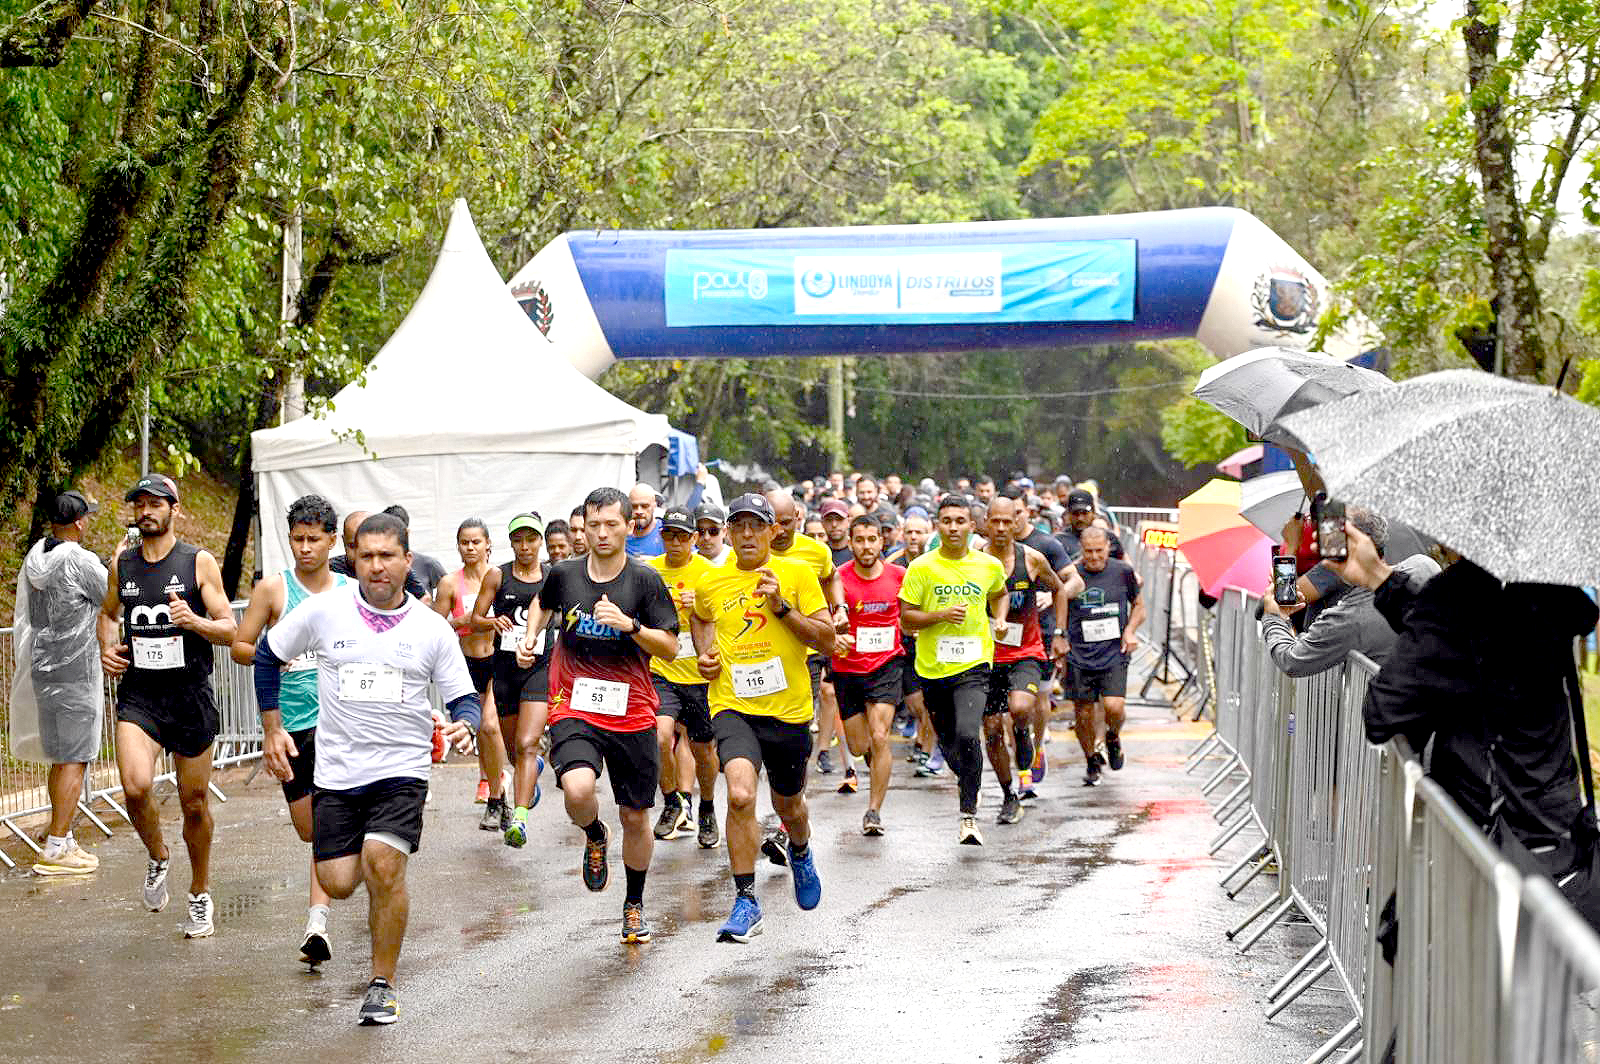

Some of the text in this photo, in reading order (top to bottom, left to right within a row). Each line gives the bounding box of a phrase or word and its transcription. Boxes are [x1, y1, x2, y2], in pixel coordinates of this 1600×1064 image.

[838, 274, 893, 289] LINDOYA
[906, 275, 995, 289] DISTRITOS
[934, 585, 971, 596] GOOD
[147, 651, 163, 660] 175
[951, 647, 965, 655] 163
[360, 679, 374, 690] 87
[746, 676, 764, 687] 116
[591, 693, 603, 703] 53
